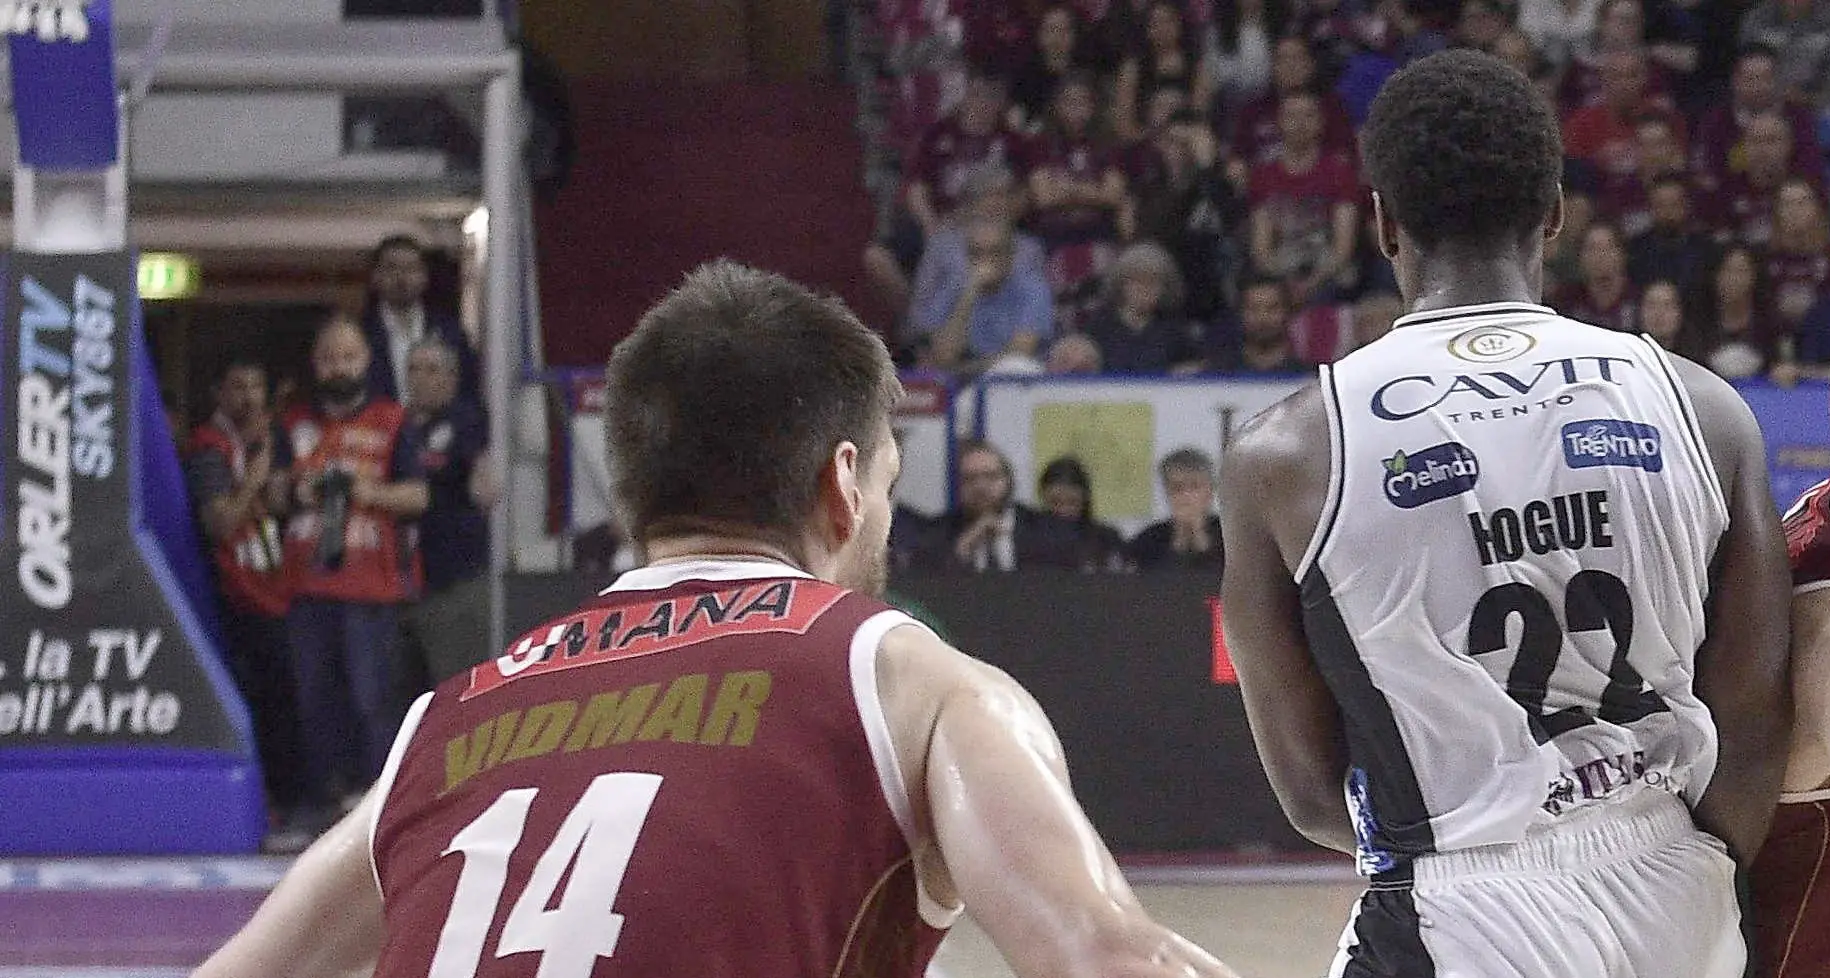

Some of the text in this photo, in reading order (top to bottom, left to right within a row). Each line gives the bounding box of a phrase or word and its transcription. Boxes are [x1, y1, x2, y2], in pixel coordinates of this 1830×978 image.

[1370, 356, 1636, 421] CAVIT
[1449, 395, 1574, 423] TRENTO
[1467, 490, 1614, 566] HOGUE
[23, 628, 162, 681] la TV
[497, 579, 796, 678] UMANA
[1469, 569, 1671, 747] 22
[436, 671, 772, 799] VIDMAR
